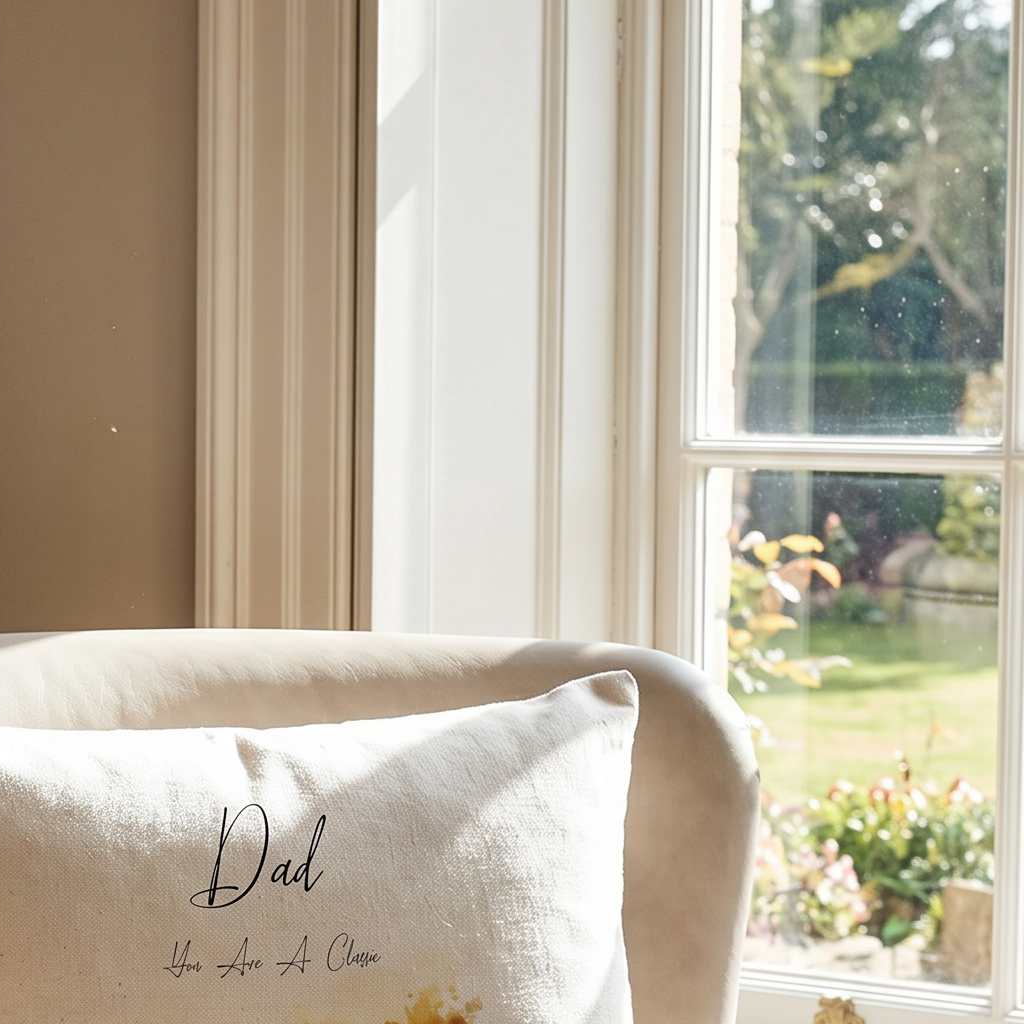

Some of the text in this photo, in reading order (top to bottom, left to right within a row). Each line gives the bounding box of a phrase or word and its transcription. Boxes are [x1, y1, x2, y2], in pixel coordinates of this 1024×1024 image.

[189, 803, 326, 909] Dad
[163, 932, 382, 979] You Are A Classic
